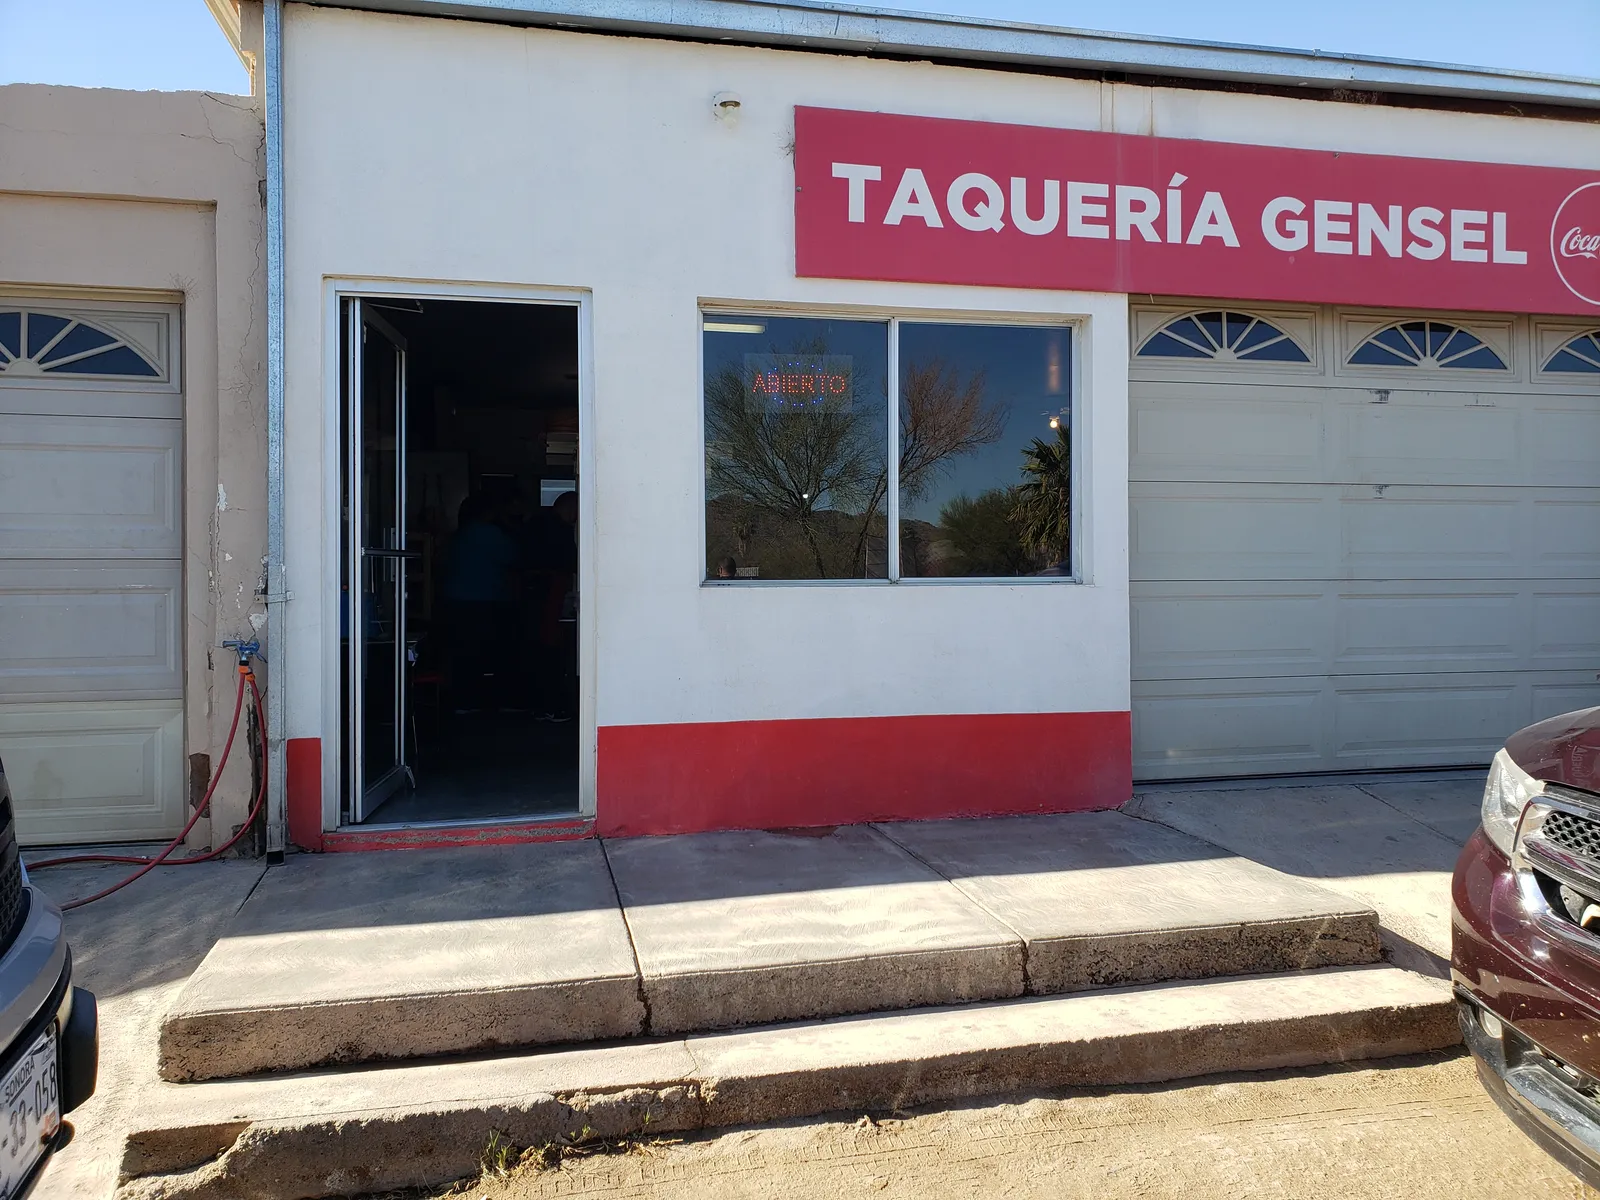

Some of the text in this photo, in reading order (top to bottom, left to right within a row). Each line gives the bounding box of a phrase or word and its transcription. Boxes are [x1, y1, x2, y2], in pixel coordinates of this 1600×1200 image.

[831, 162, 1528, 265] TAQUERÍA GENSEL
[752, 373, 846, 394] ABIERTO
[5, 1055, 36, 1101] SONORA
